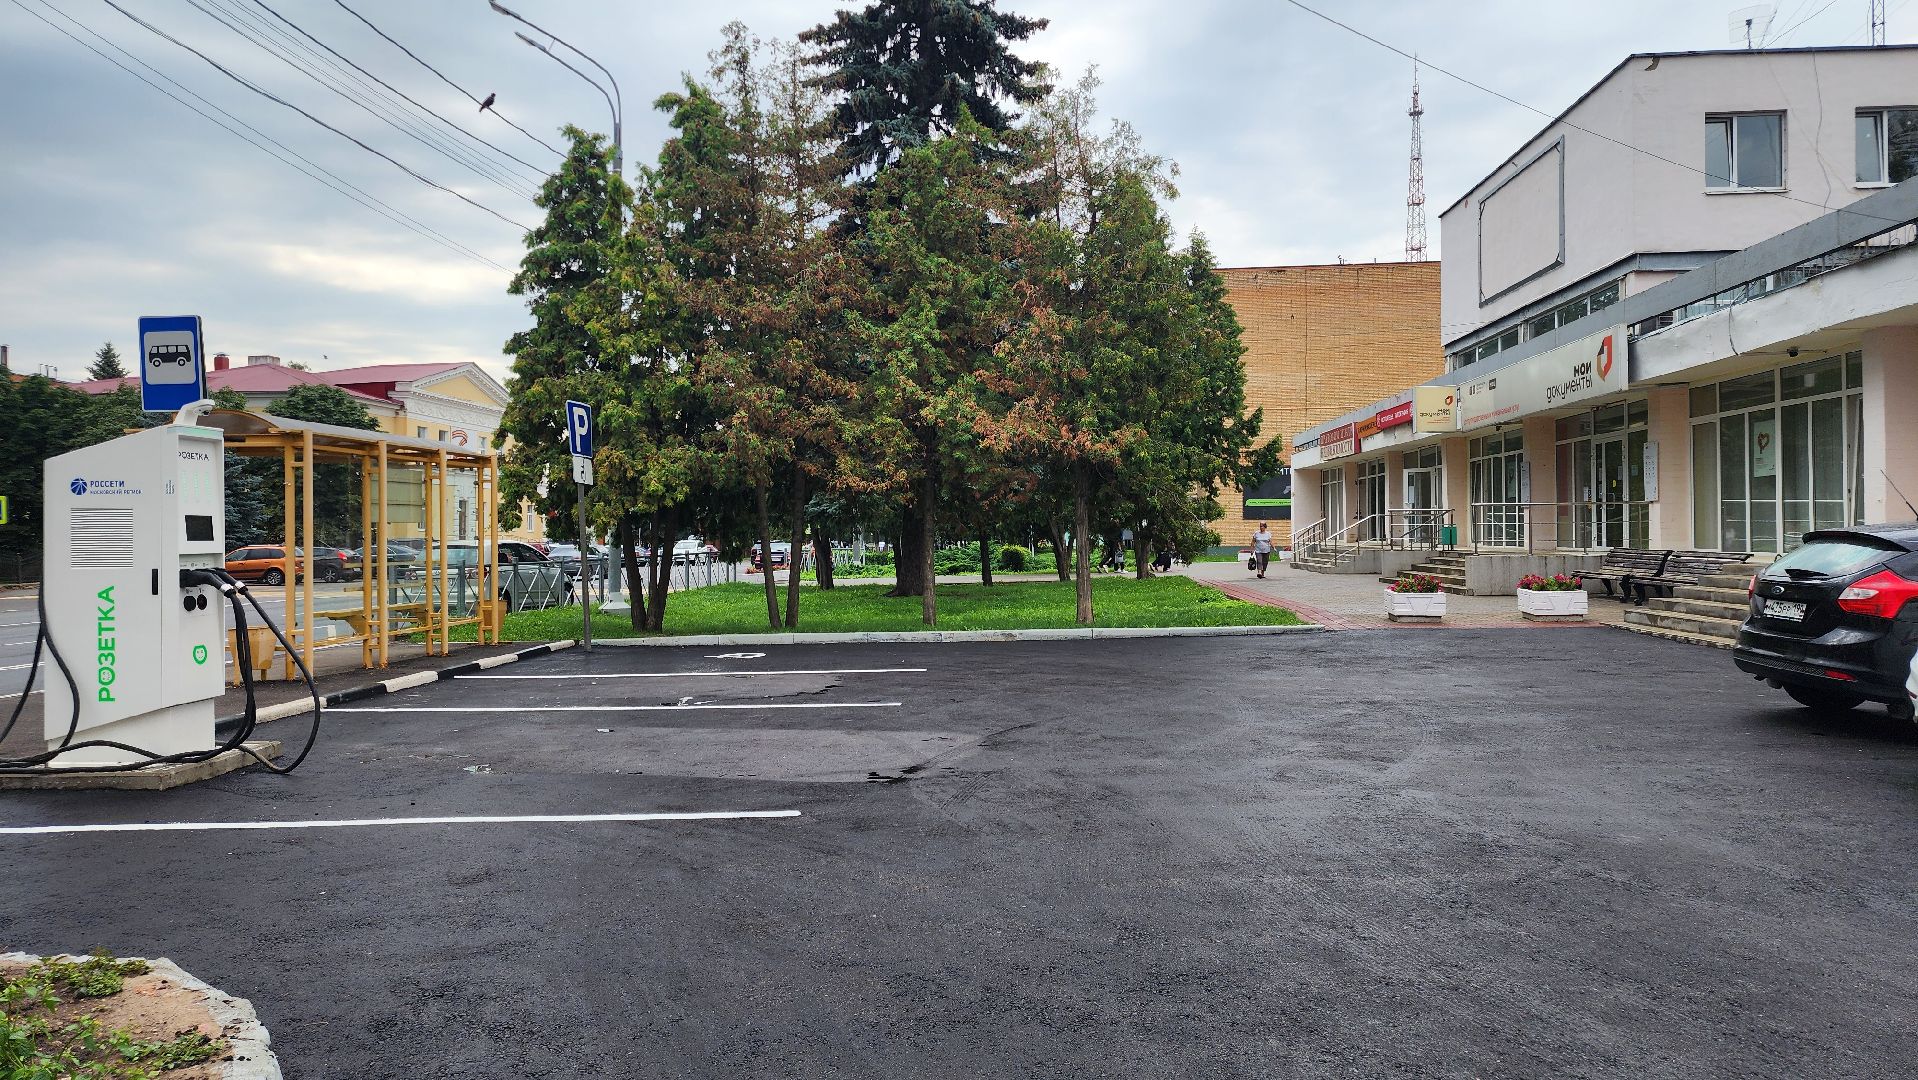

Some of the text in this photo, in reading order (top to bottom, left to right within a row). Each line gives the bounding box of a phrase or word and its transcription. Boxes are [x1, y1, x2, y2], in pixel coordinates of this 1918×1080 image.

[1546, 375, 1593, 403] документы
[573, 406, 589, 453] P
[90, 480, 125, 488] РОССЕТИ
[97, 585, 116, 702] РОЗЕТКА
